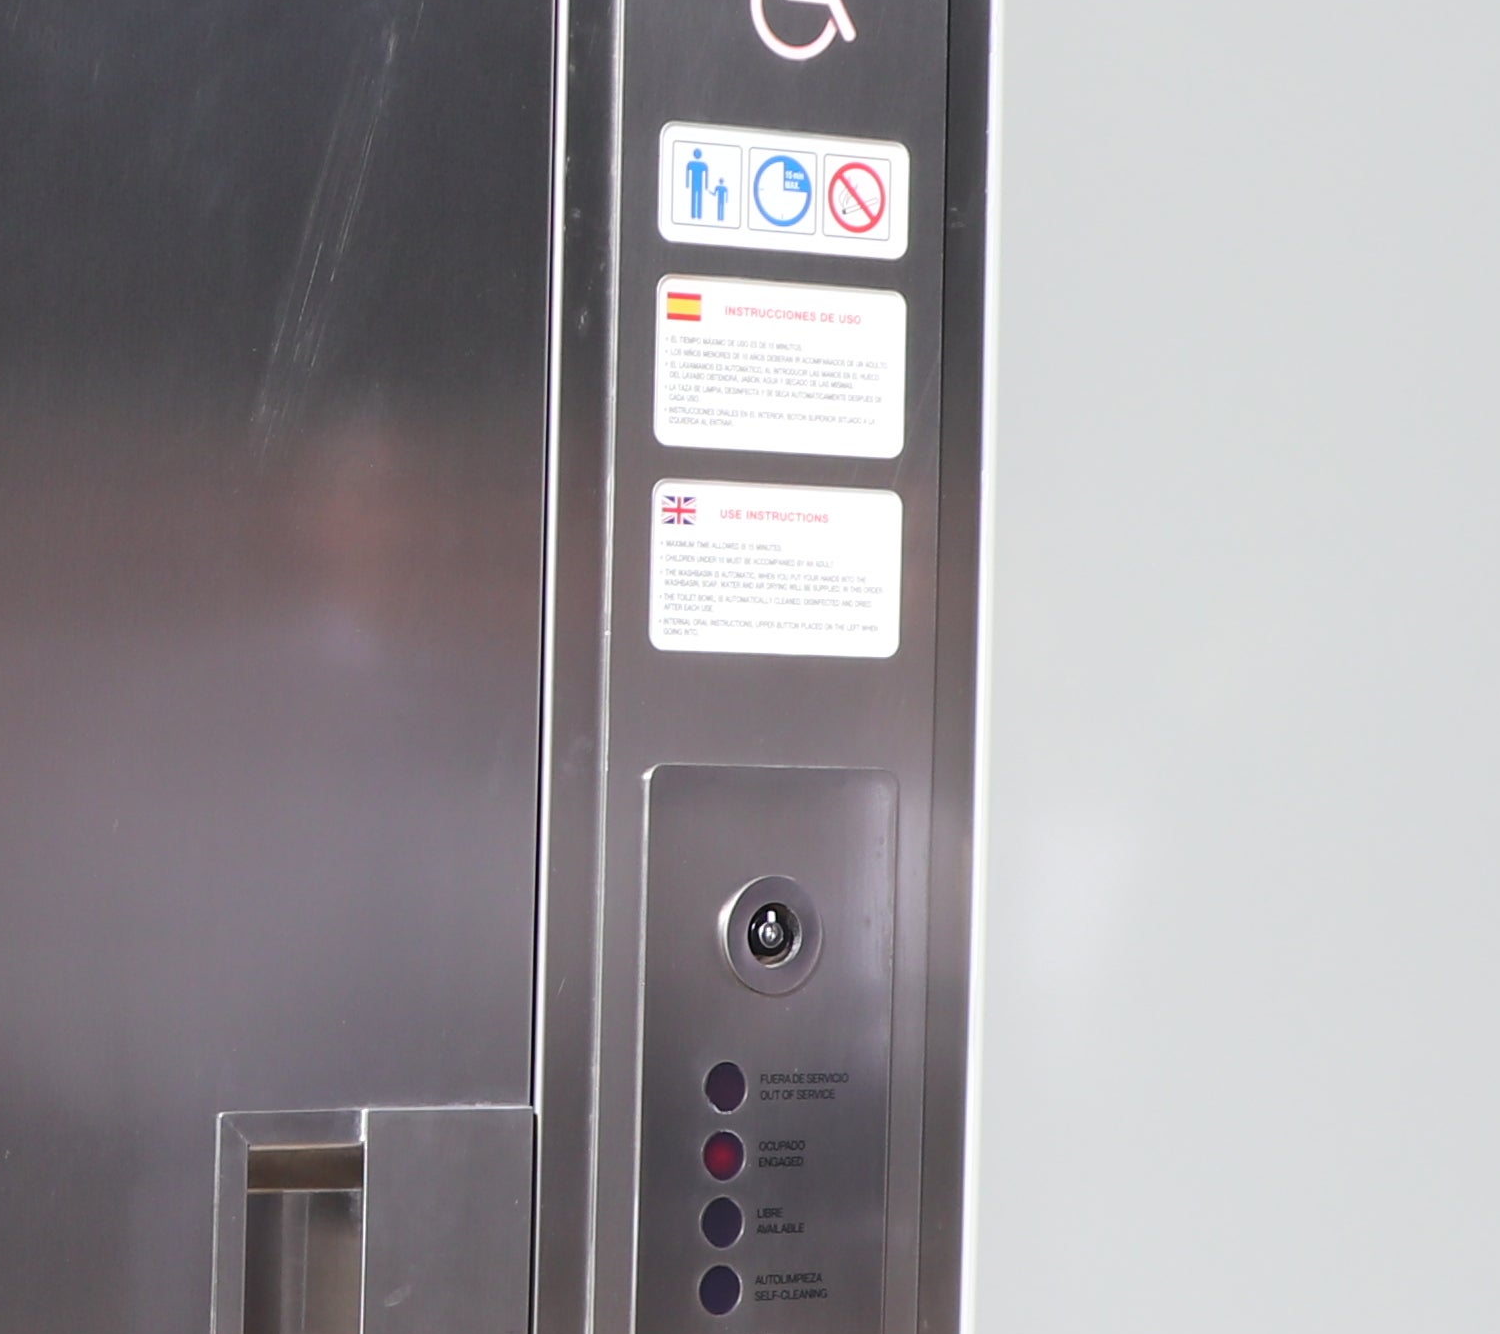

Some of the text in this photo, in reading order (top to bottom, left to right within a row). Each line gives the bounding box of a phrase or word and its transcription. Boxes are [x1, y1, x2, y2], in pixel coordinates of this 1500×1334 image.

[724, 305, 862, 325] INSTRUCCIONES DE USO
[720, 508, 829, 523] USE INSTRUCTIONS
[760, 1073, 849, 1084] FUERA DE SERVICIO
[760, 1088, 836, 1100] OUT OF SERVICE
[758, 1140, 806, 1152] OCUPADO
[758, 1156, 804, 1167] ENGAGED
[757, 1207, 784, 1219] LIBRE
[756, 1222, 805, 1234] AVAILABLE
[755, 1272, 823, 1285] AUTOLIMPIEZA
[754, 1288, 828, 1301] SELF-CLEANING
